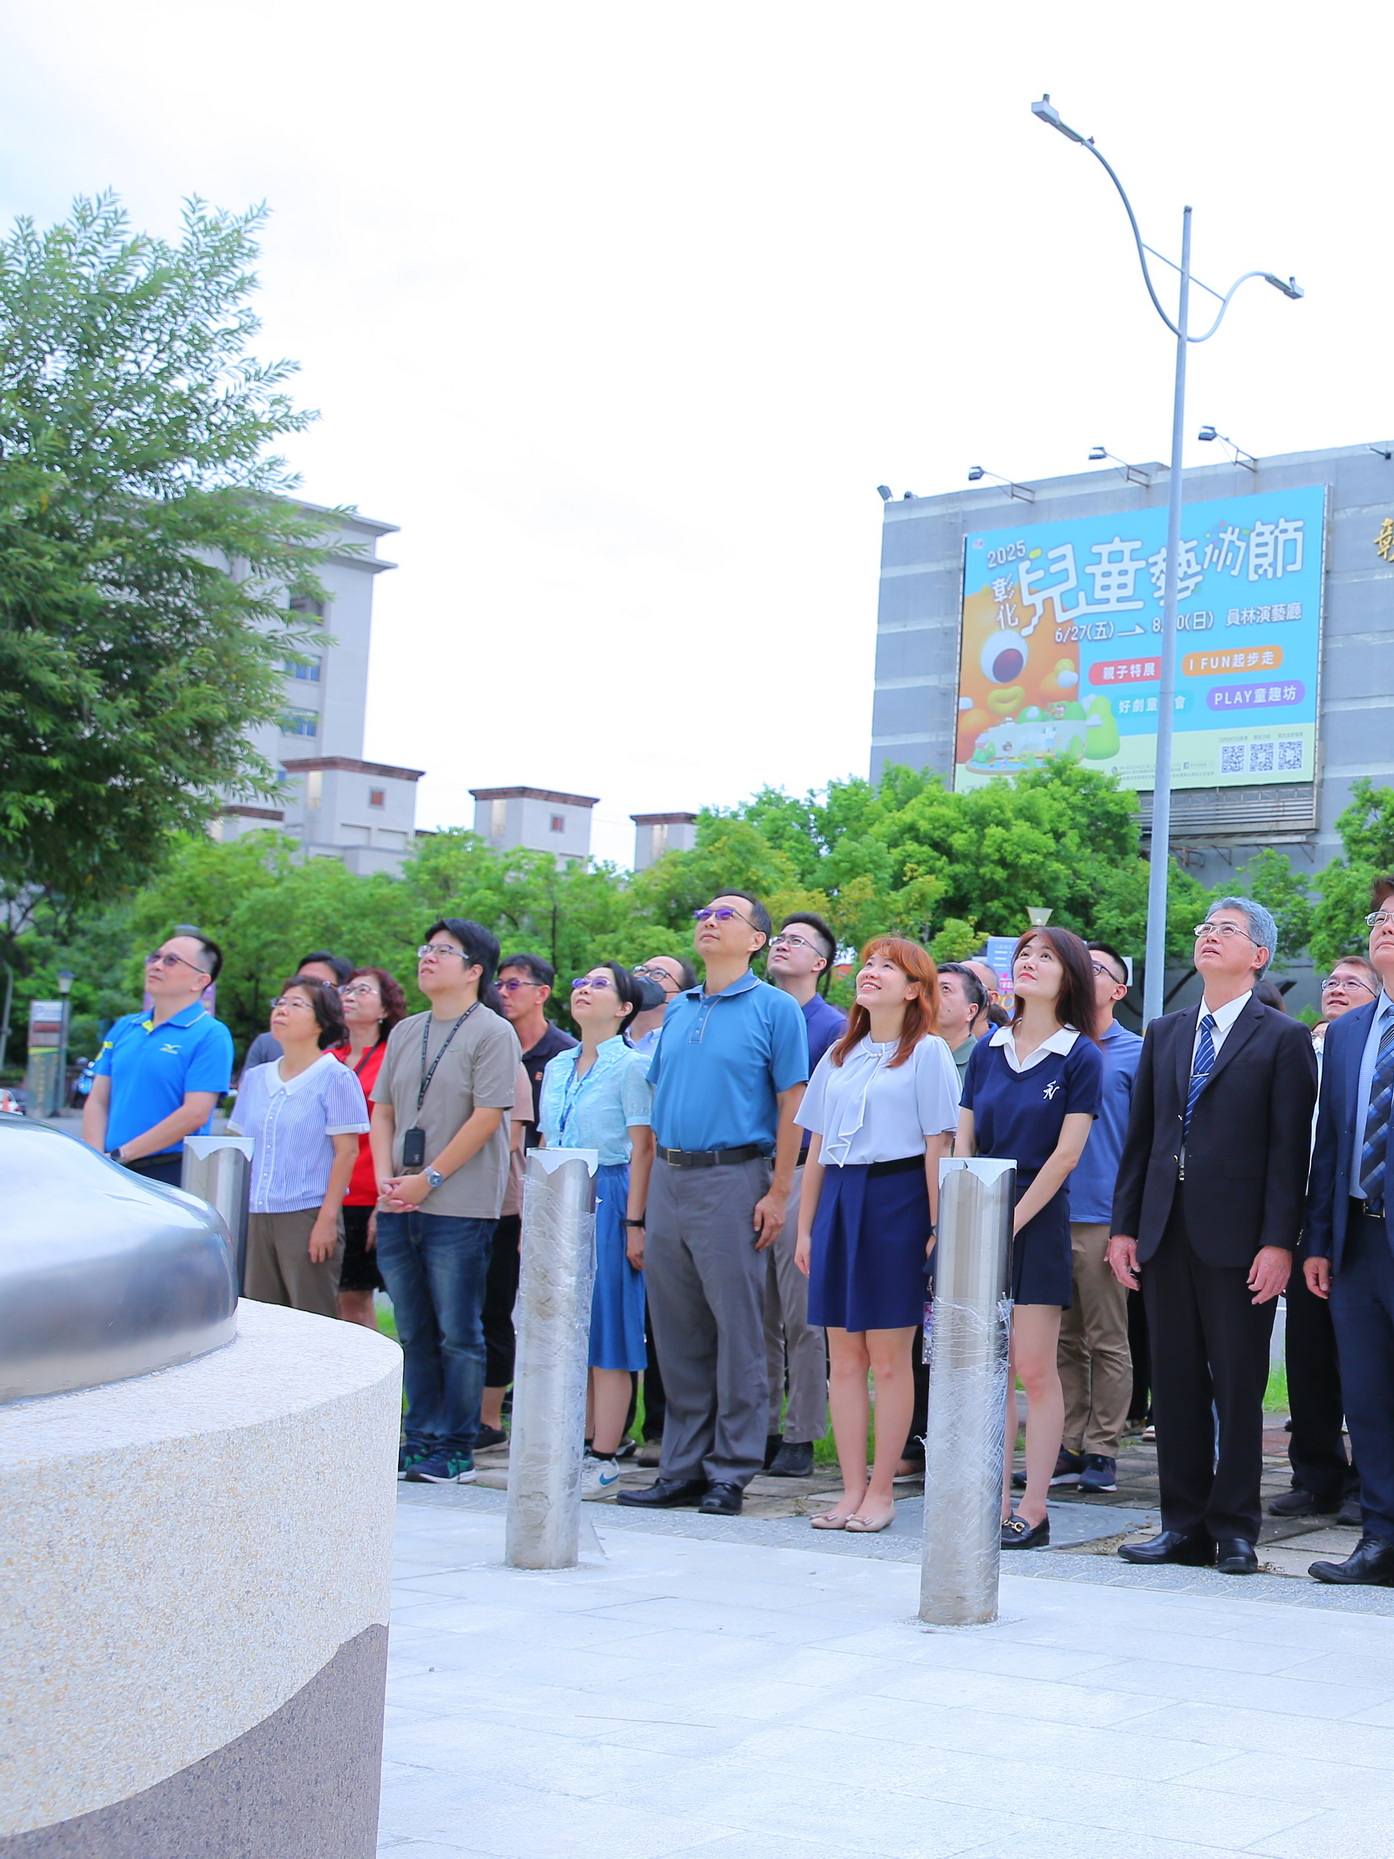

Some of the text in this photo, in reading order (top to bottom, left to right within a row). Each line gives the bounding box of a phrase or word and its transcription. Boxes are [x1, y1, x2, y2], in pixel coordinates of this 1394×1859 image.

[987, 540, 1026, 569] 2025
[1018, 517, 1304, 638] 兒童藝術節
[992, 573, 1019, 631] 彰化
[1055, 602, 1302, 643] 6/27(五) 80(日) 員林演藝廳
[1102, 662, 1156, 681] 親子特展
[1201, 650, 1275, 670] FUN起步走
[1118, 695, 1187, 715] 好劇童會
[1214, 685, 1298, 706] PLAY童趣坊
